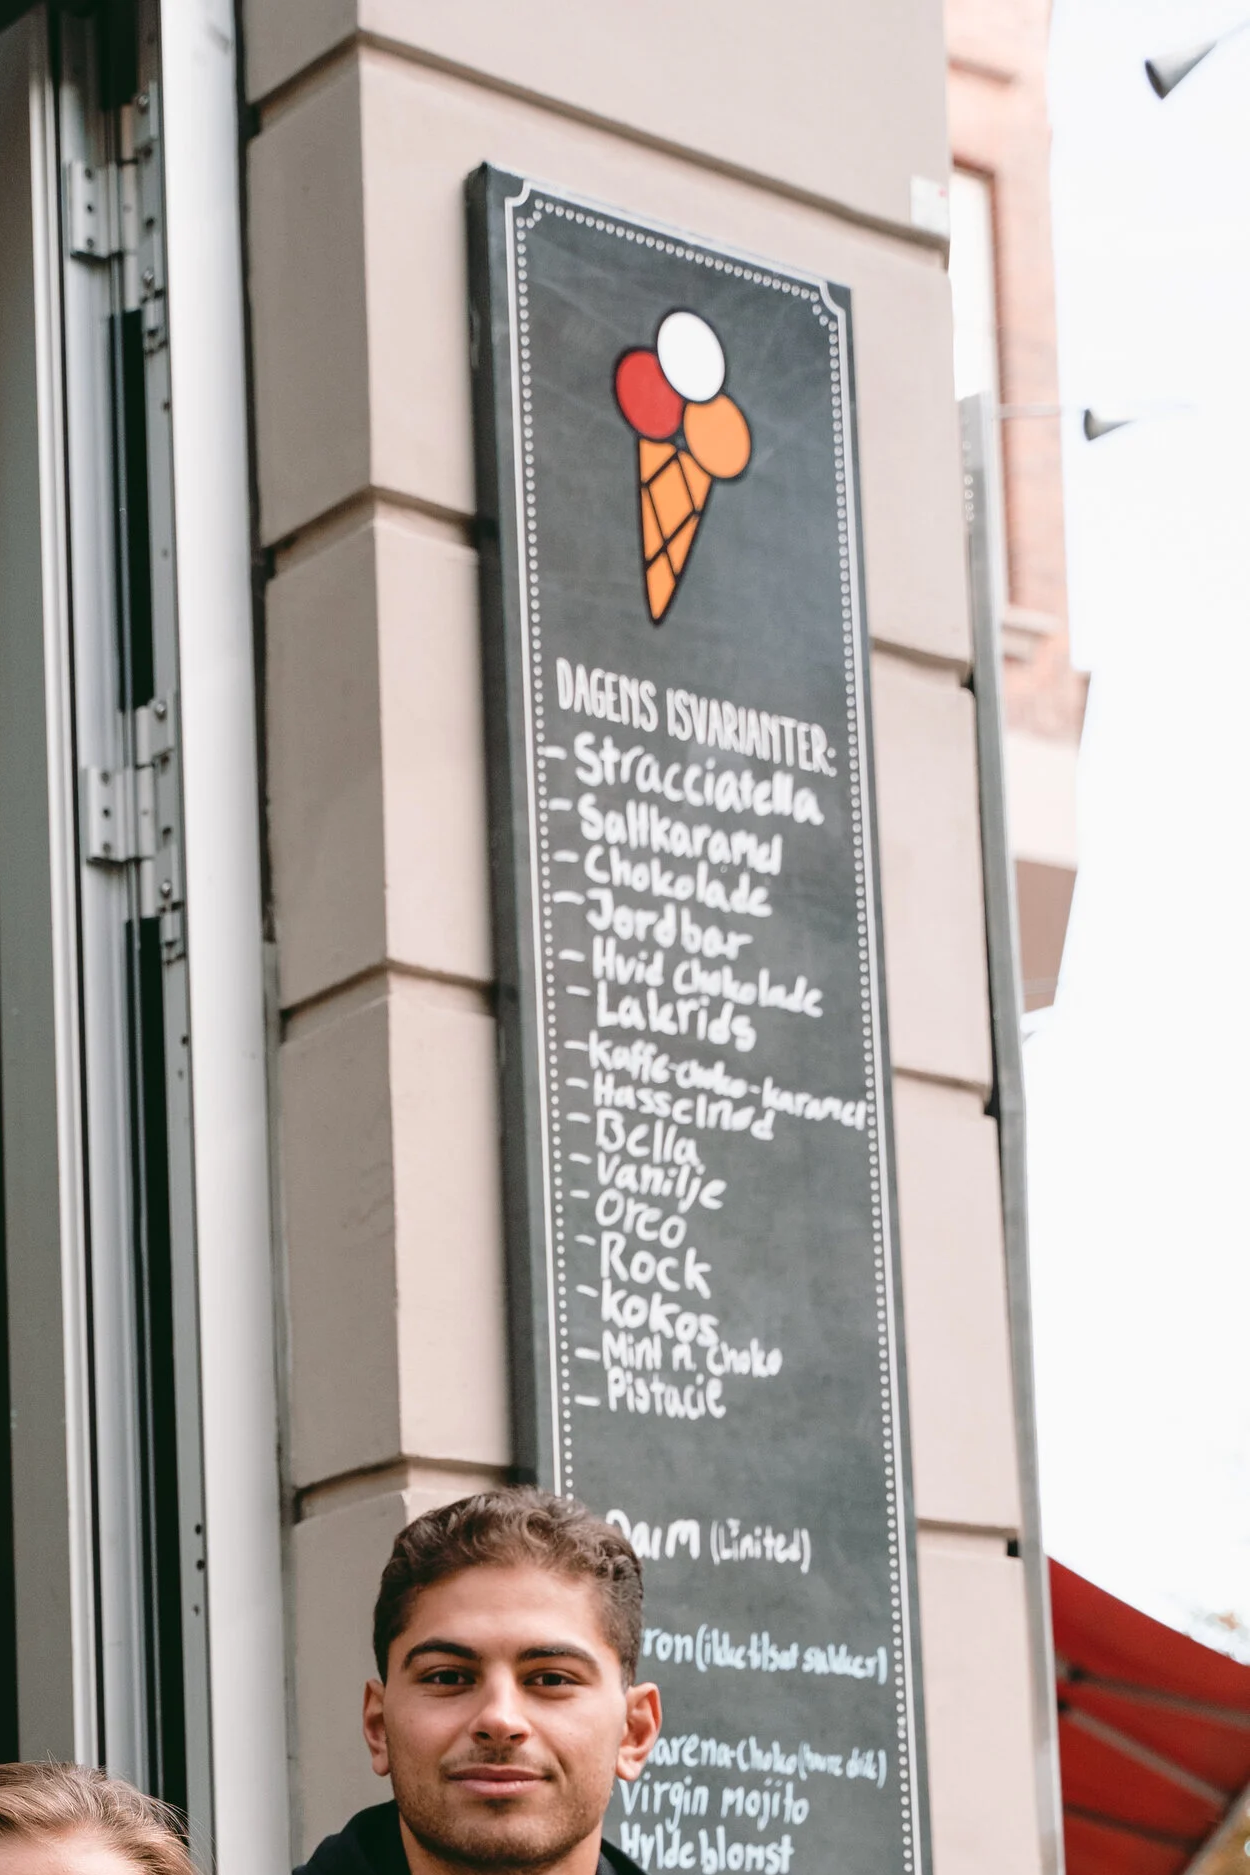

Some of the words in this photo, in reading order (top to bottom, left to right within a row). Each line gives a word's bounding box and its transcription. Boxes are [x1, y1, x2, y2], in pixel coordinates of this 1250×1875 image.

[556, 657, 659, 732] DAGENS
[573, 731, 825, 825] Stracciatella
[584, 845, 773, 917] Chokolade
[593, 934, 664, 987] Hvid
[597, 979, 757, 1052] Lakrids
[596, 1108, 700, 1167] Bella
[597, 1151, 727, 1214] Vanilje
[595, 1188, 687, 1249] Oreo
[600, 1230, 712, 1300] Rock
[618, 1771, 710, 1833] Virgin
